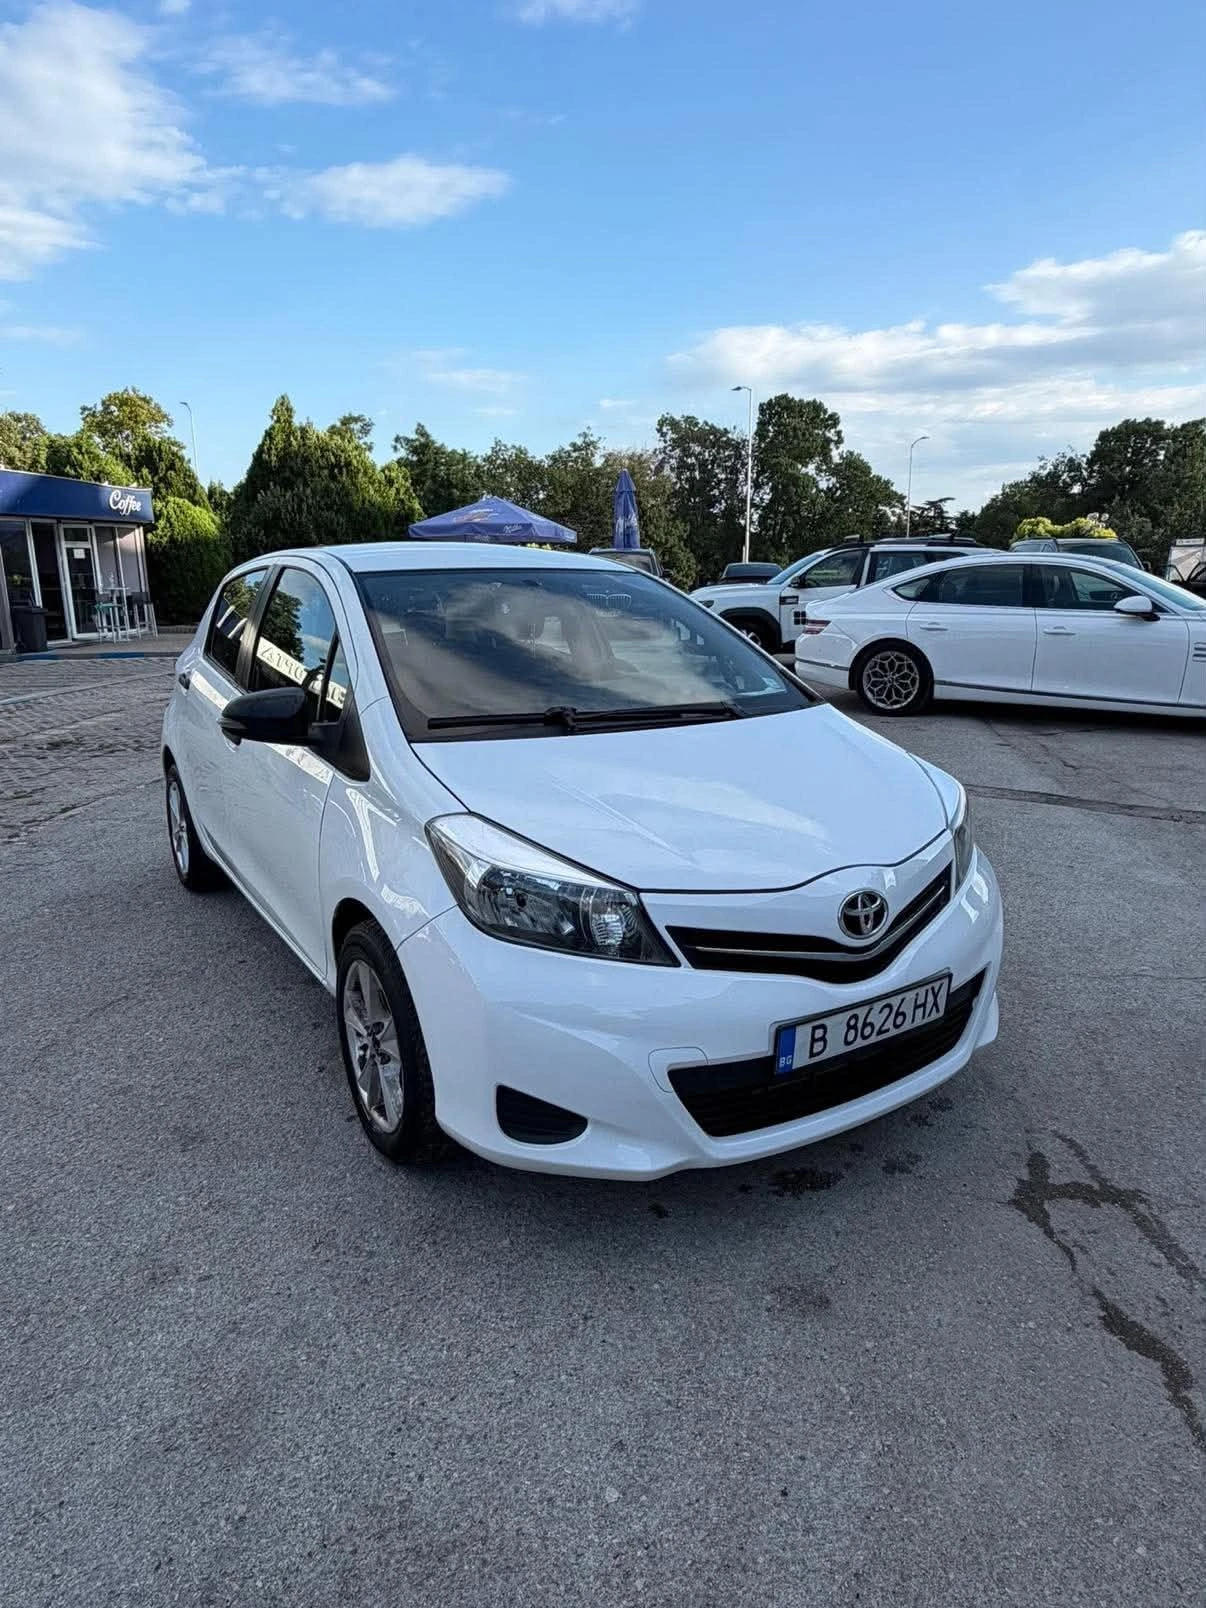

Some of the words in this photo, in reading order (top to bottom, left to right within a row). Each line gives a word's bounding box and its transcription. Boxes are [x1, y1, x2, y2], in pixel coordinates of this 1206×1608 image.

[109, 490, 142, 516] Coffee
[809, 1023, 828, 1059] B
[779, 1055, 793, 1068] BG
